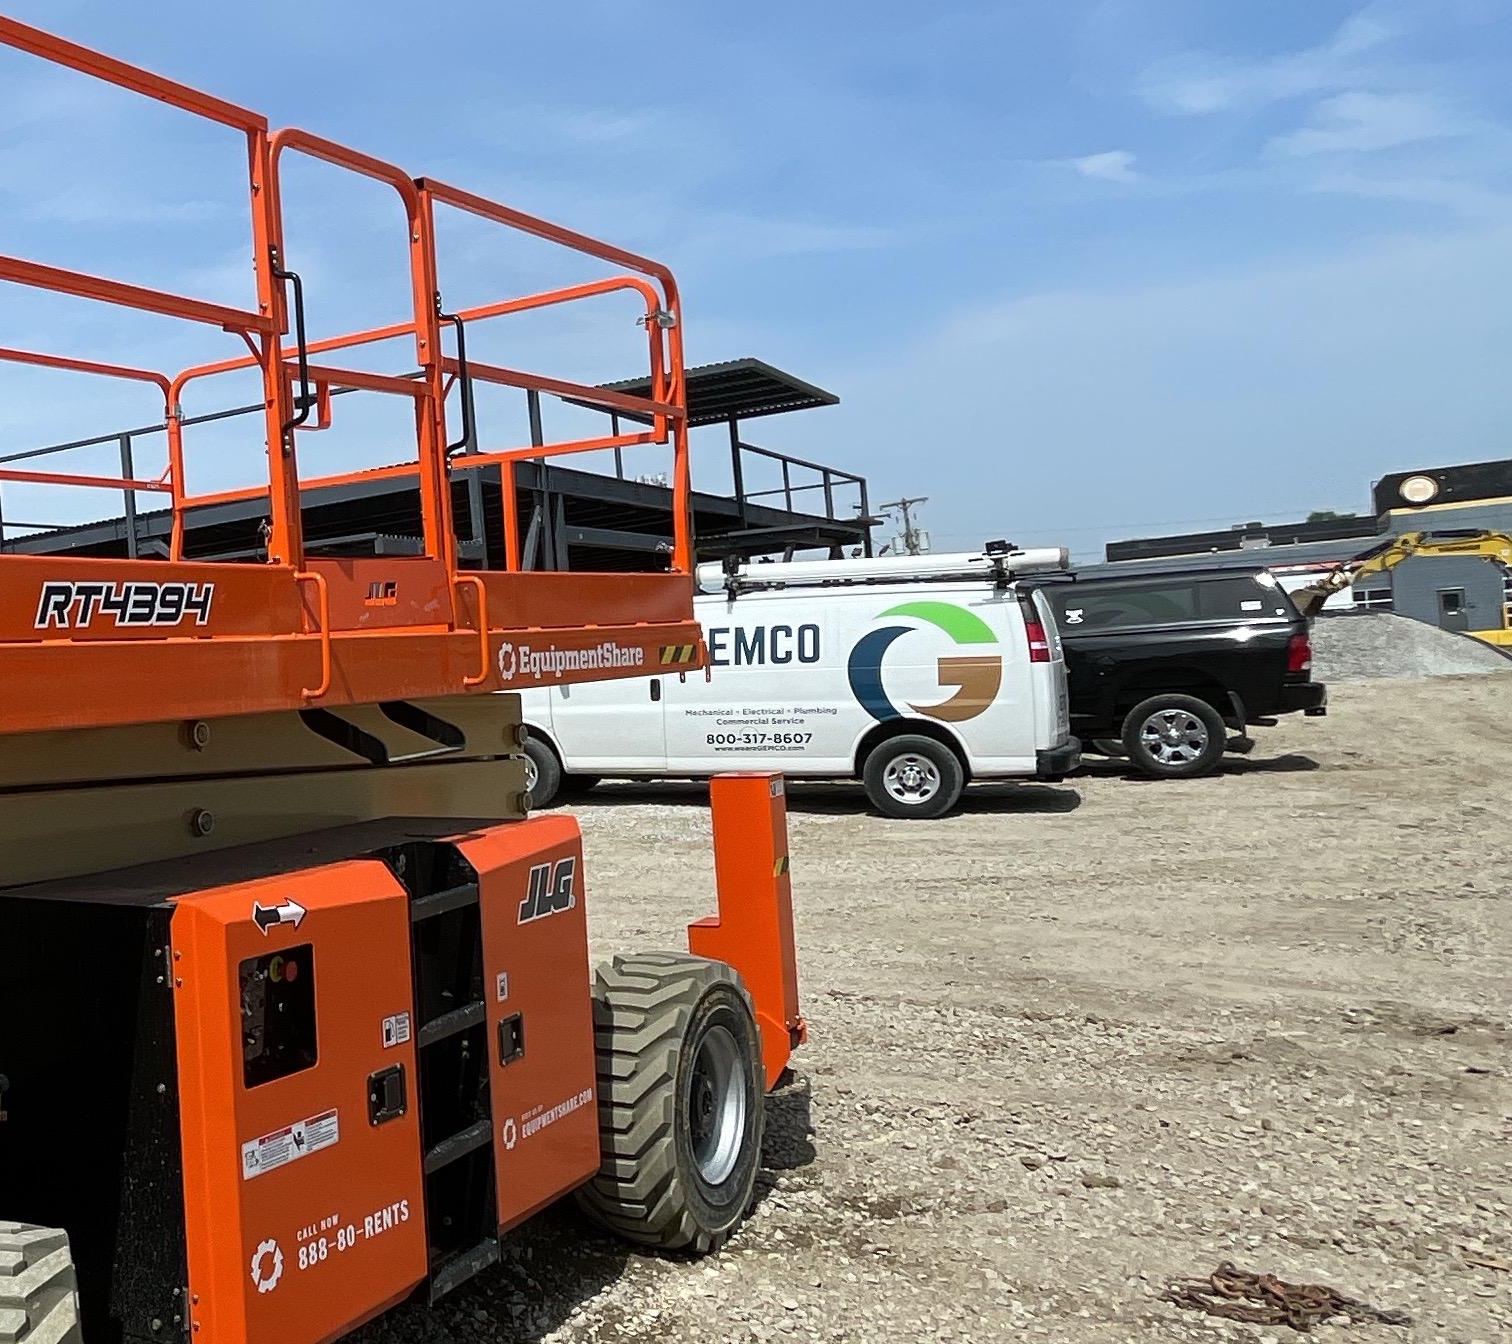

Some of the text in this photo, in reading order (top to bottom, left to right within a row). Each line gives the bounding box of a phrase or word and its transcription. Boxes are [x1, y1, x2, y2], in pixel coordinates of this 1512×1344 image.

[34, 581, 214, 629] RT4394
[518, 642, 644, 679] EquipmentShare
[707, 623, 821, 666] EMCO
[793, 707, 838, 715] Plumbing
[706, 733, 813, 744] 800-317-8607
[517, 856, 576, 925] JLG
[296, 1213, 340, 1242] CALL NOW
[298, 1199, 410, 1270] 888-80-RENTS
